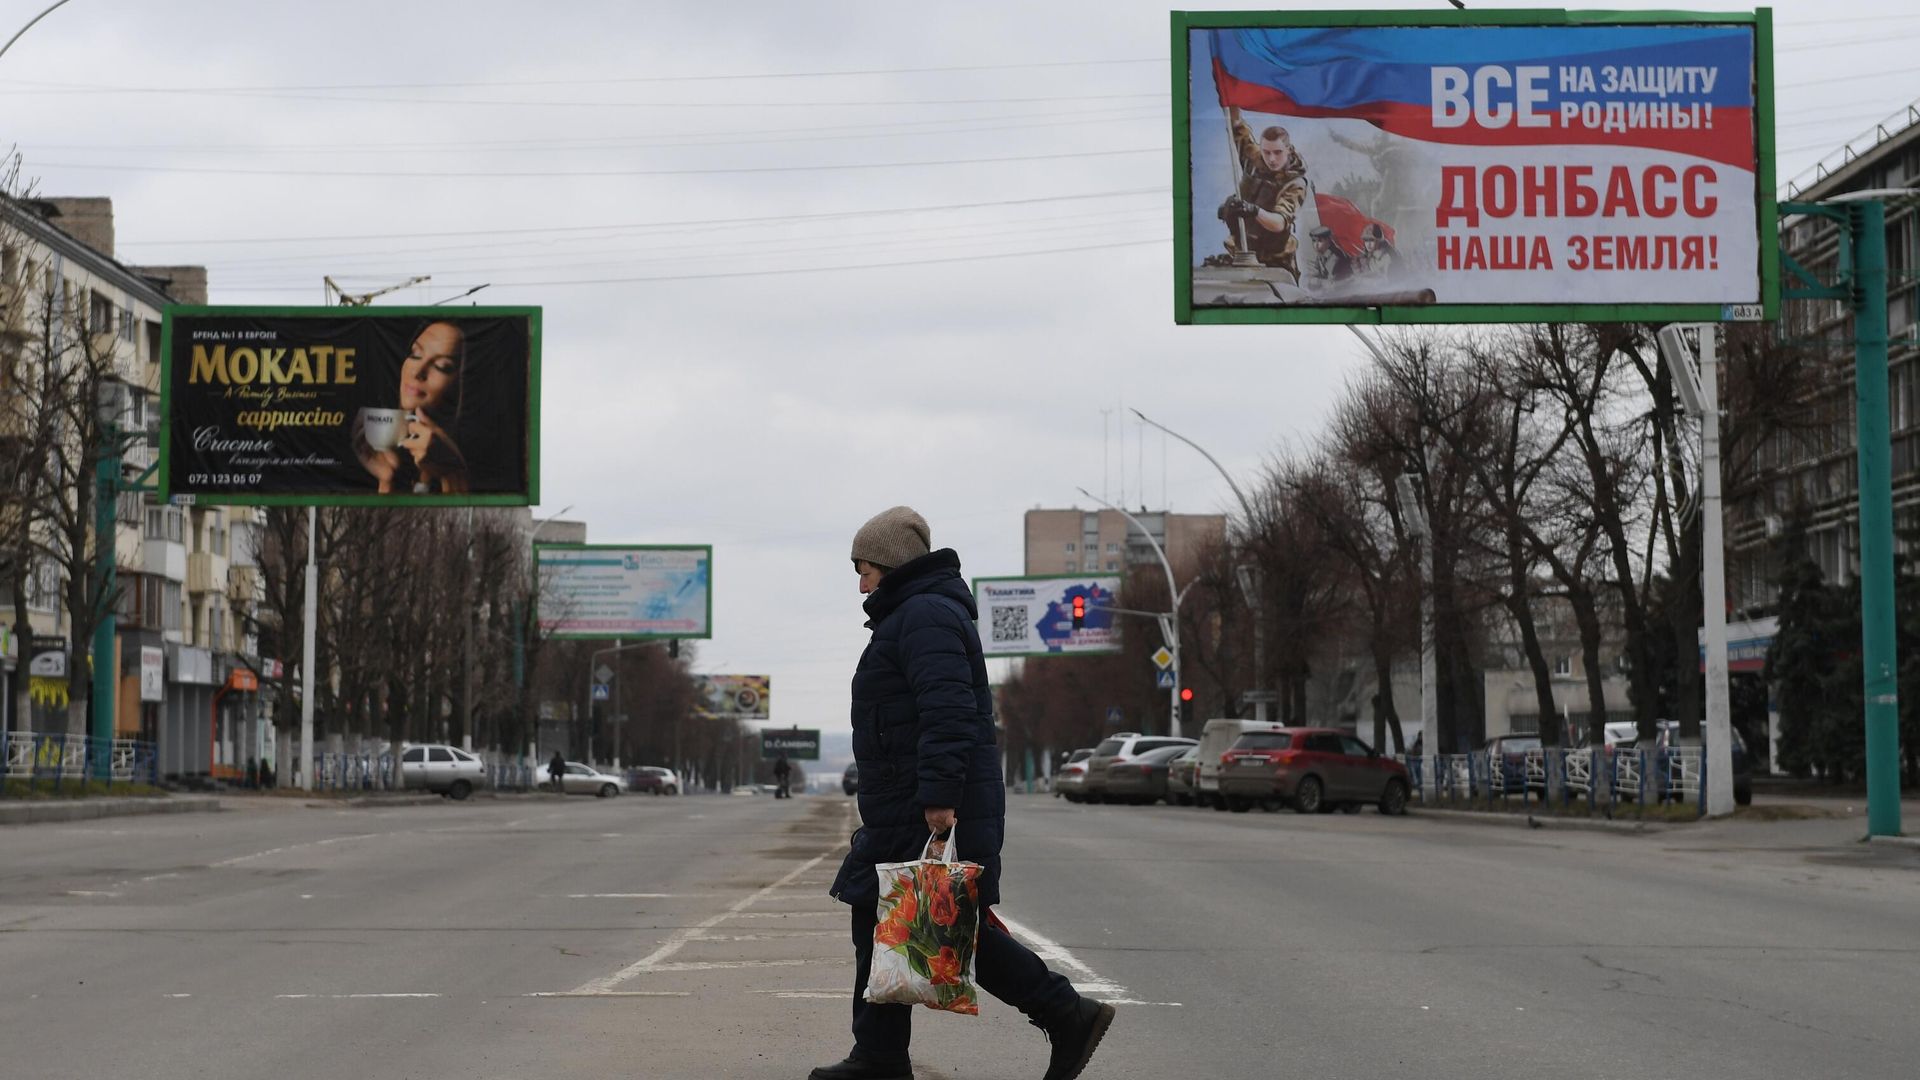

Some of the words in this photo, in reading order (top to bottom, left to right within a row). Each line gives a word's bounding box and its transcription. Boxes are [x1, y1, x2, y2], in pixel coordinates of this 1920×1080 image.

[1430, 65, 1551, 129] ВСЕ
[1559, 66, 1597, 93] НА
[1601, 66, 1718, 98] ЗАЩИТУ
[1560, 101, 1713, 133] РОДИНЫ!
[1436, 165, 1718, 228] ДОНБАСС
[1437, 235, 1553, 270] НАША
[1566, 235, 1718, 270] ЗЕМЛЯ!
[193, 331, 220, 340] БРЕНД
[238, 331, 245, 340] В
[245, 331, 277, 340] ЕВРОПЕ
[189, 345, 357, 384] MOKATE
[237, 407, 345, 431] cappuccino
[193, 425, 274, 451] Счастье
[188, 473, 208, 484] 072
[212, 473, 231, 484] 123
[232, 473, 247, 484] 05
[248, 473, 263, 484] 07
